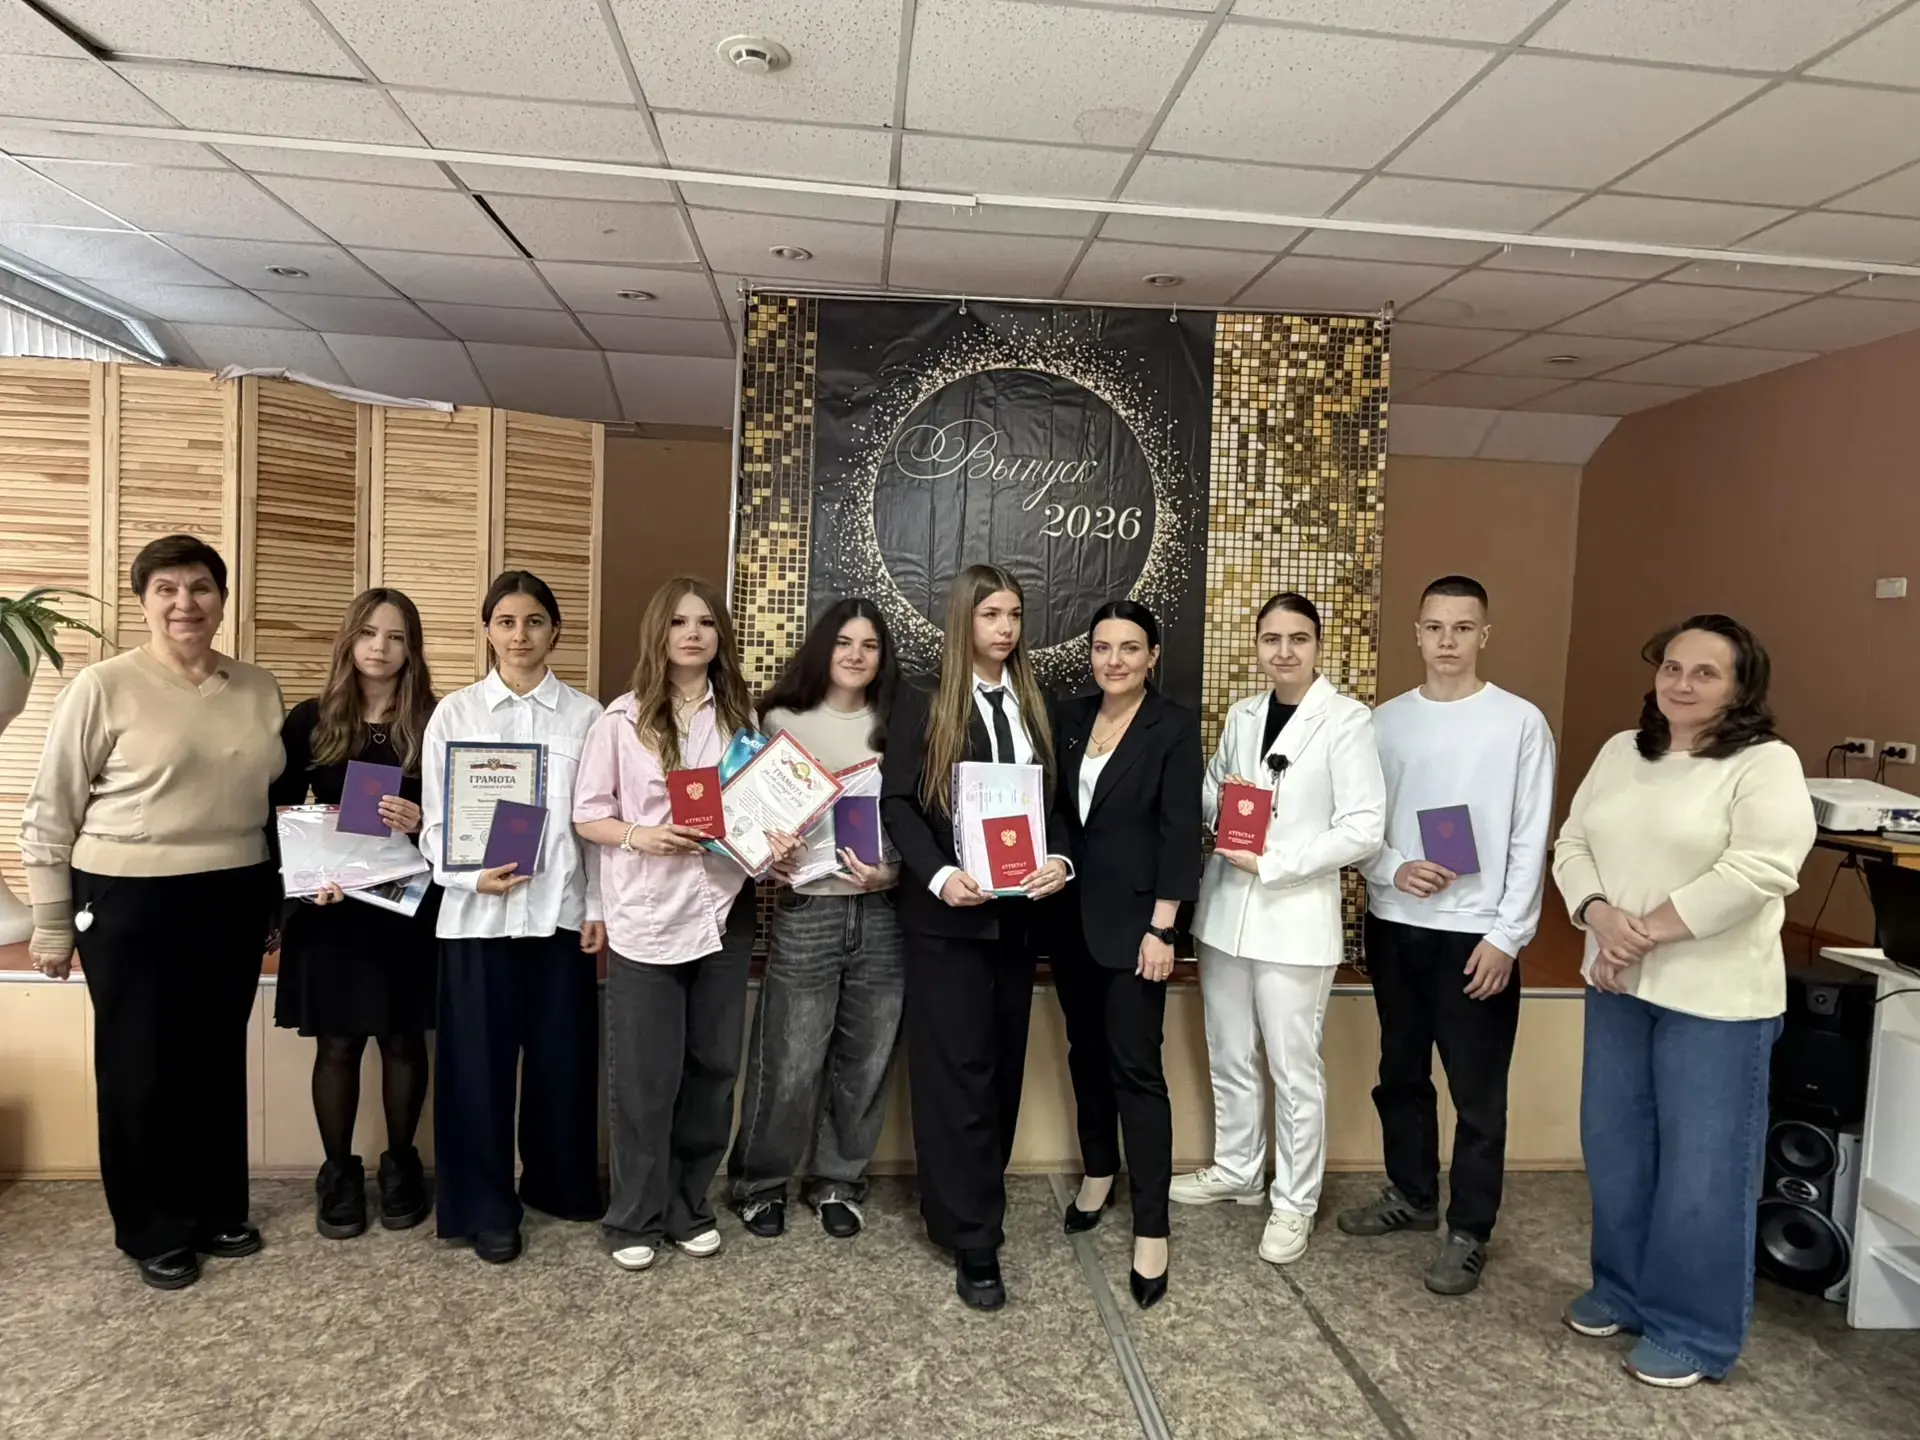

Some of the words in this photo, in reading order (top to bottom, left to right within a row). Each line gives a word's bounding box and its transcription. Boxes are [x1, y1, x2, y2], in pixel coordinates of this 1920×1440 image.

[895, 419, 1097, 511] Выпуск
[1038, 504, 1142, 540] 2026
[469, 775, 516, 784] ГРАМОТА
[773, 768, 802, 797] ГРАМОТА
